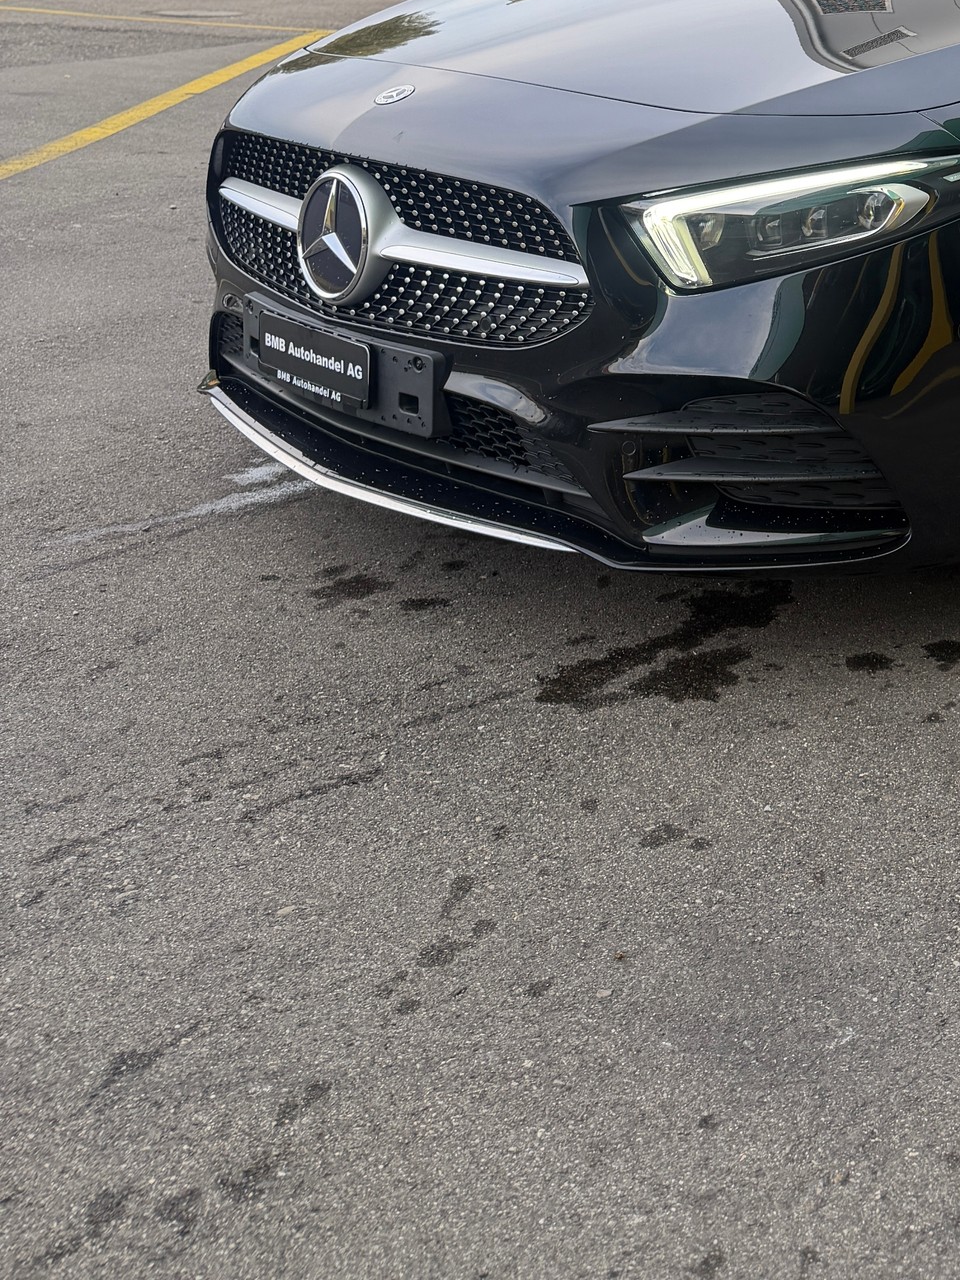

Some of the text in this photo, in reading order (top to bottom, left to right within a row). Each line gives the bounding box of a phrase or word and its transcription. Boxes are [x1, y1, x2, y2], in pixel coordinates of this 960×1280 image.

[264, 332, 363, 380] BMB Autohandel AG
[276, 369, 341, 402] BMB Autohandel AG
